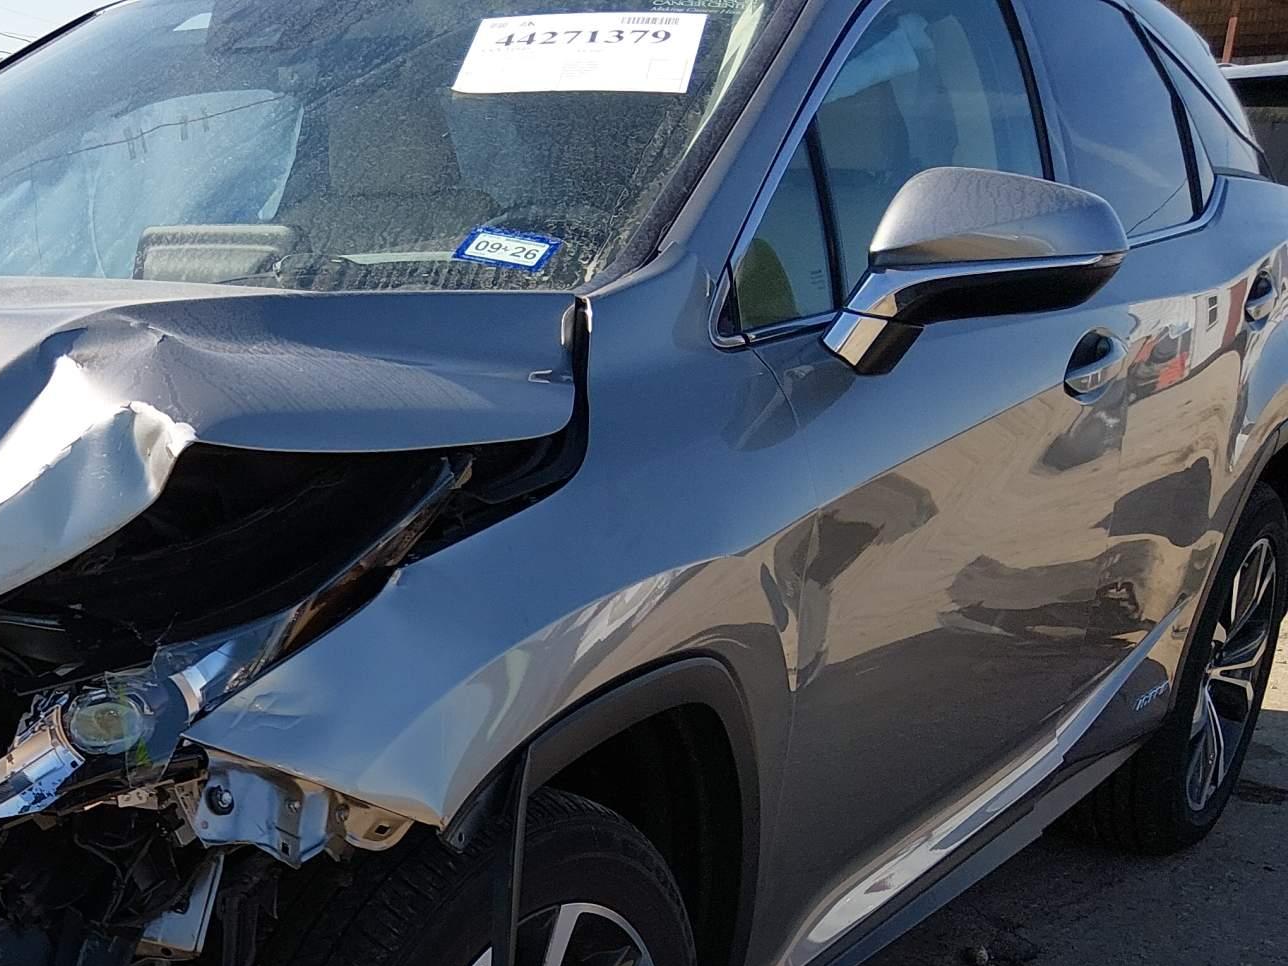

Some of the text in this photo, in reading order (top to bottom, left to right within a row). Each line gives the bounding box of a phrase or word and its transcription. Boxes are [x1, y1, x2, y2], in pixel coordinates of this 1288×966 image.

[495, 29, 672, 47] 44271379
[474, 240, 540, 260] 09 26
